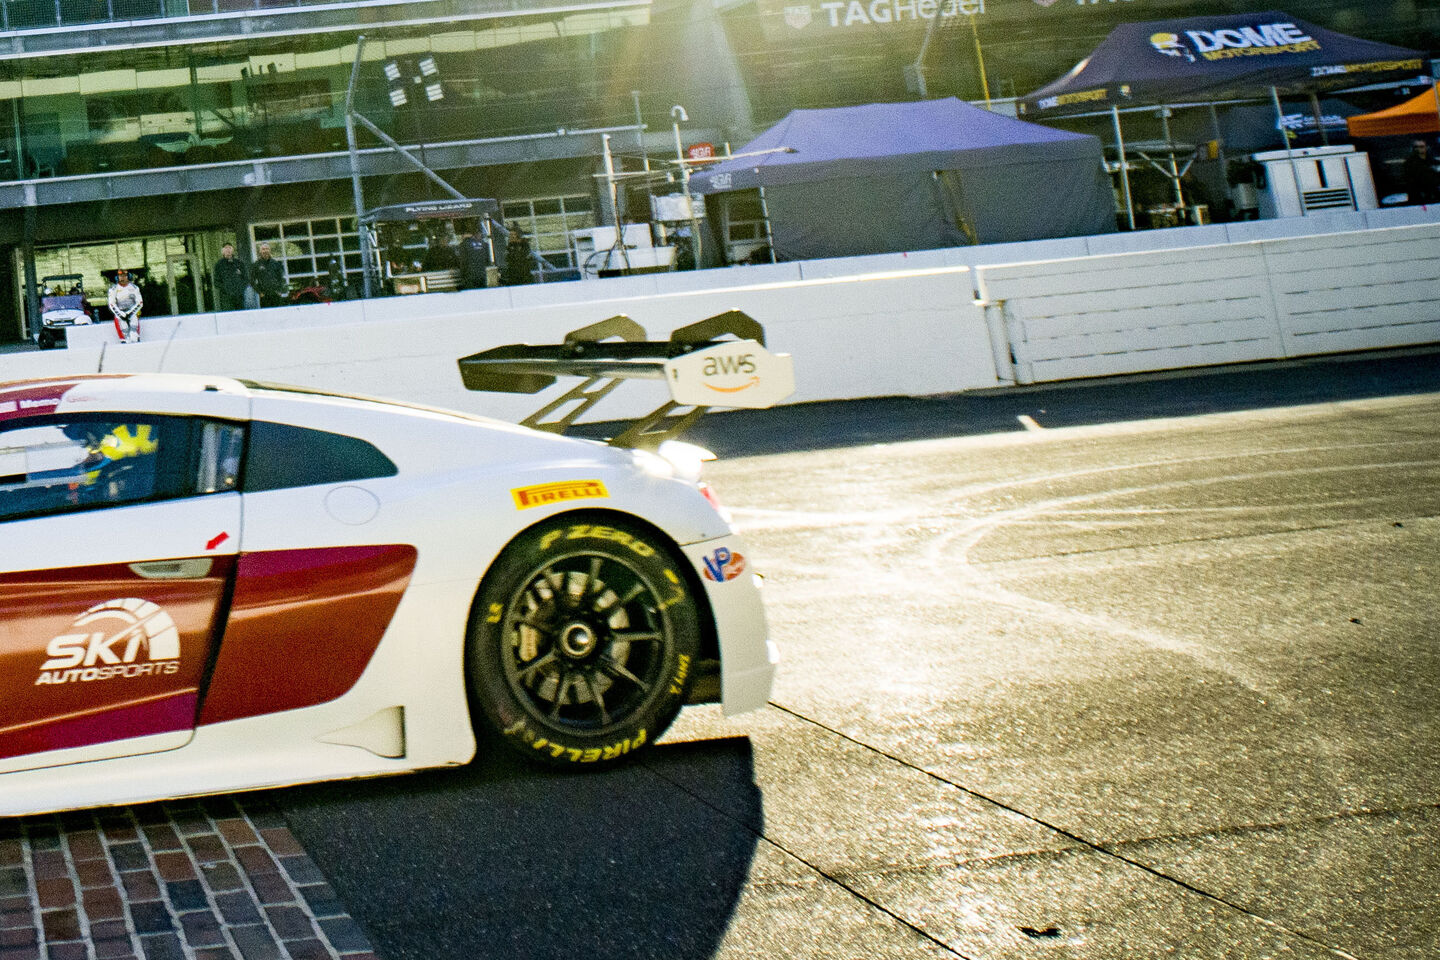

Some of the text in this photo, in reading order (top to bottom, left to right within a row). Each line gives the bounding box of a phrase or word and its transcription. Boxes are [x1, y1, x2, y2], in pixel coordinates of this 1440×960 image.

[1185, 23, 1313, 54] DOME
[703, 353, 756, 376] aws
[517, 483, 602, 506] PIRELLI
[34, 661, 180, 686] AUTOSPORTS
[532, 728, 647, 763] PIRELLI
